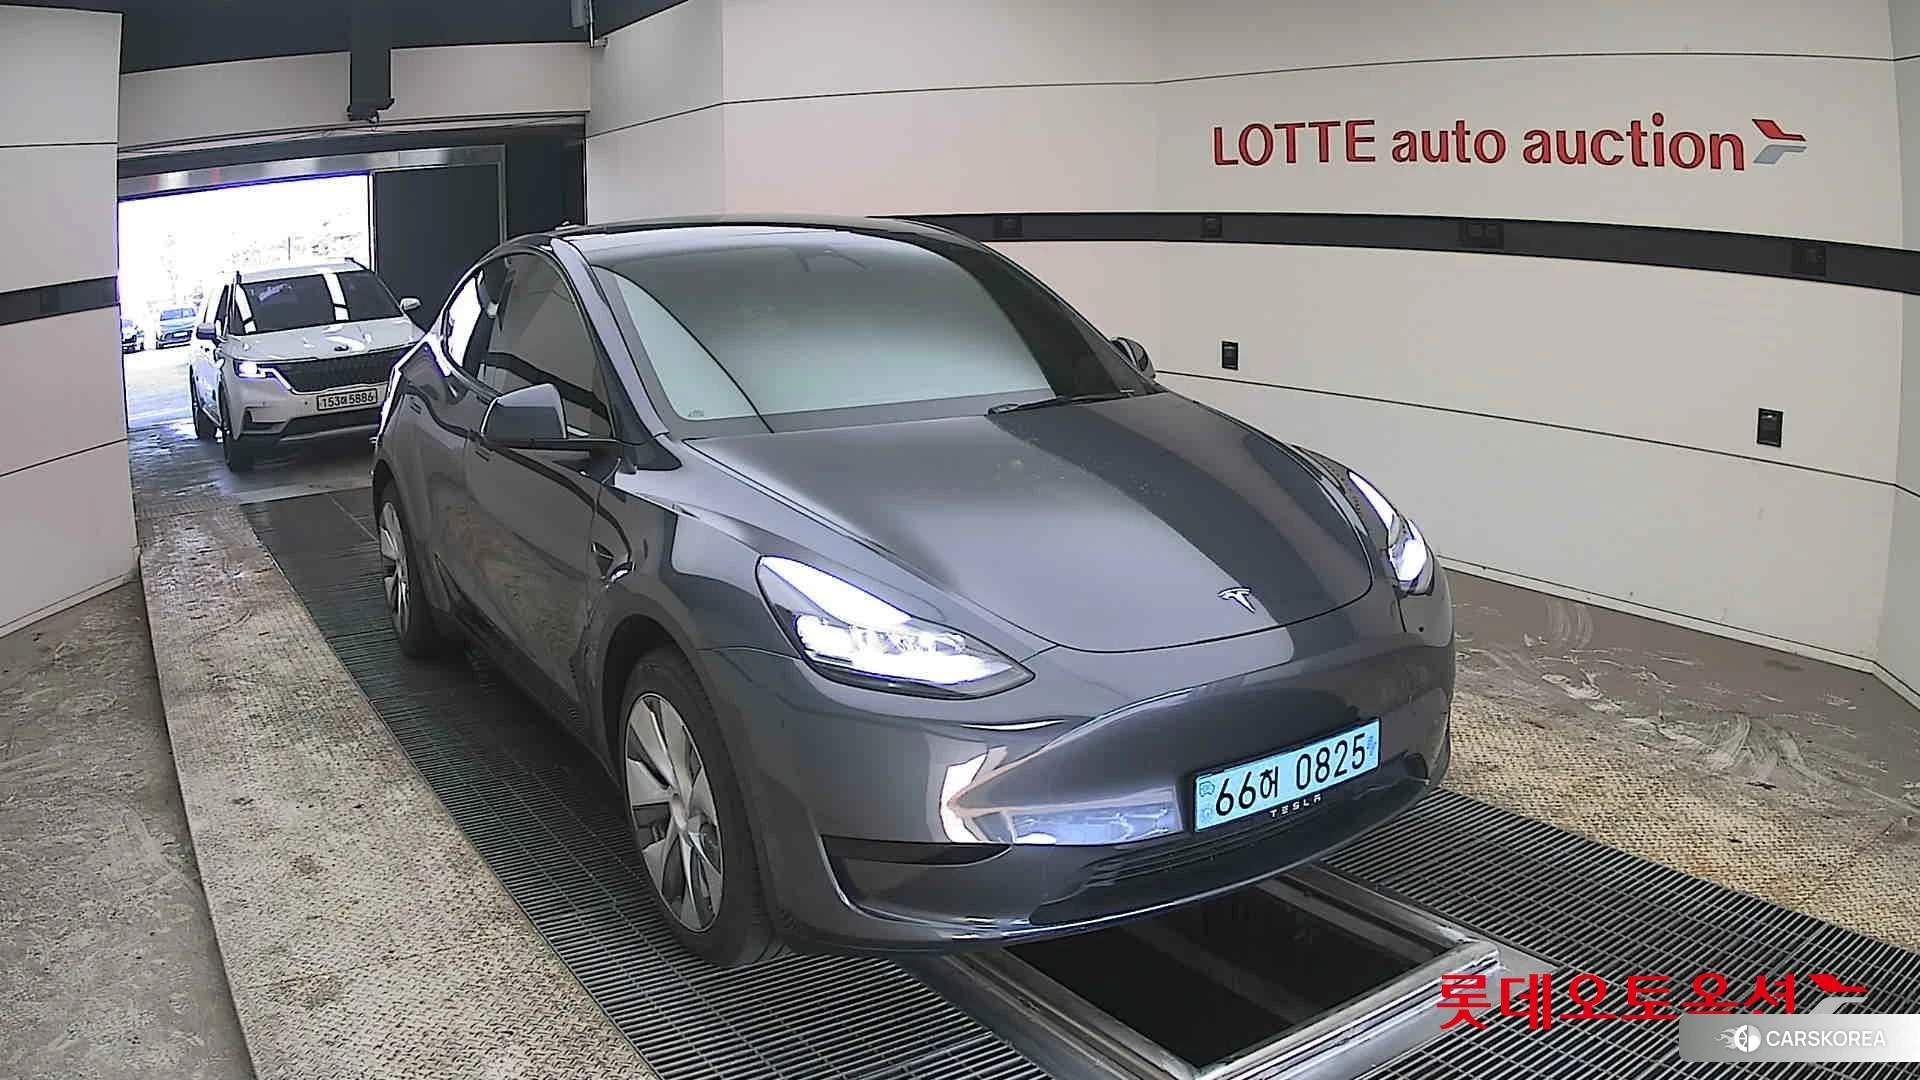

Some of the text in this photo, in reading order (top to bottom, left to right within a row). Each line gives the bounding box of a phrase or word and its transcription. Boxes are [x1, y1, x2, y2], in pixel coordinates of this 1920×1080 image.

[1213, 112, 1745, 171] LOTTE auto auction
[1215, 733, 1367, 816] 66허 0825
[1269, 794, 1321, 818] TESLA
